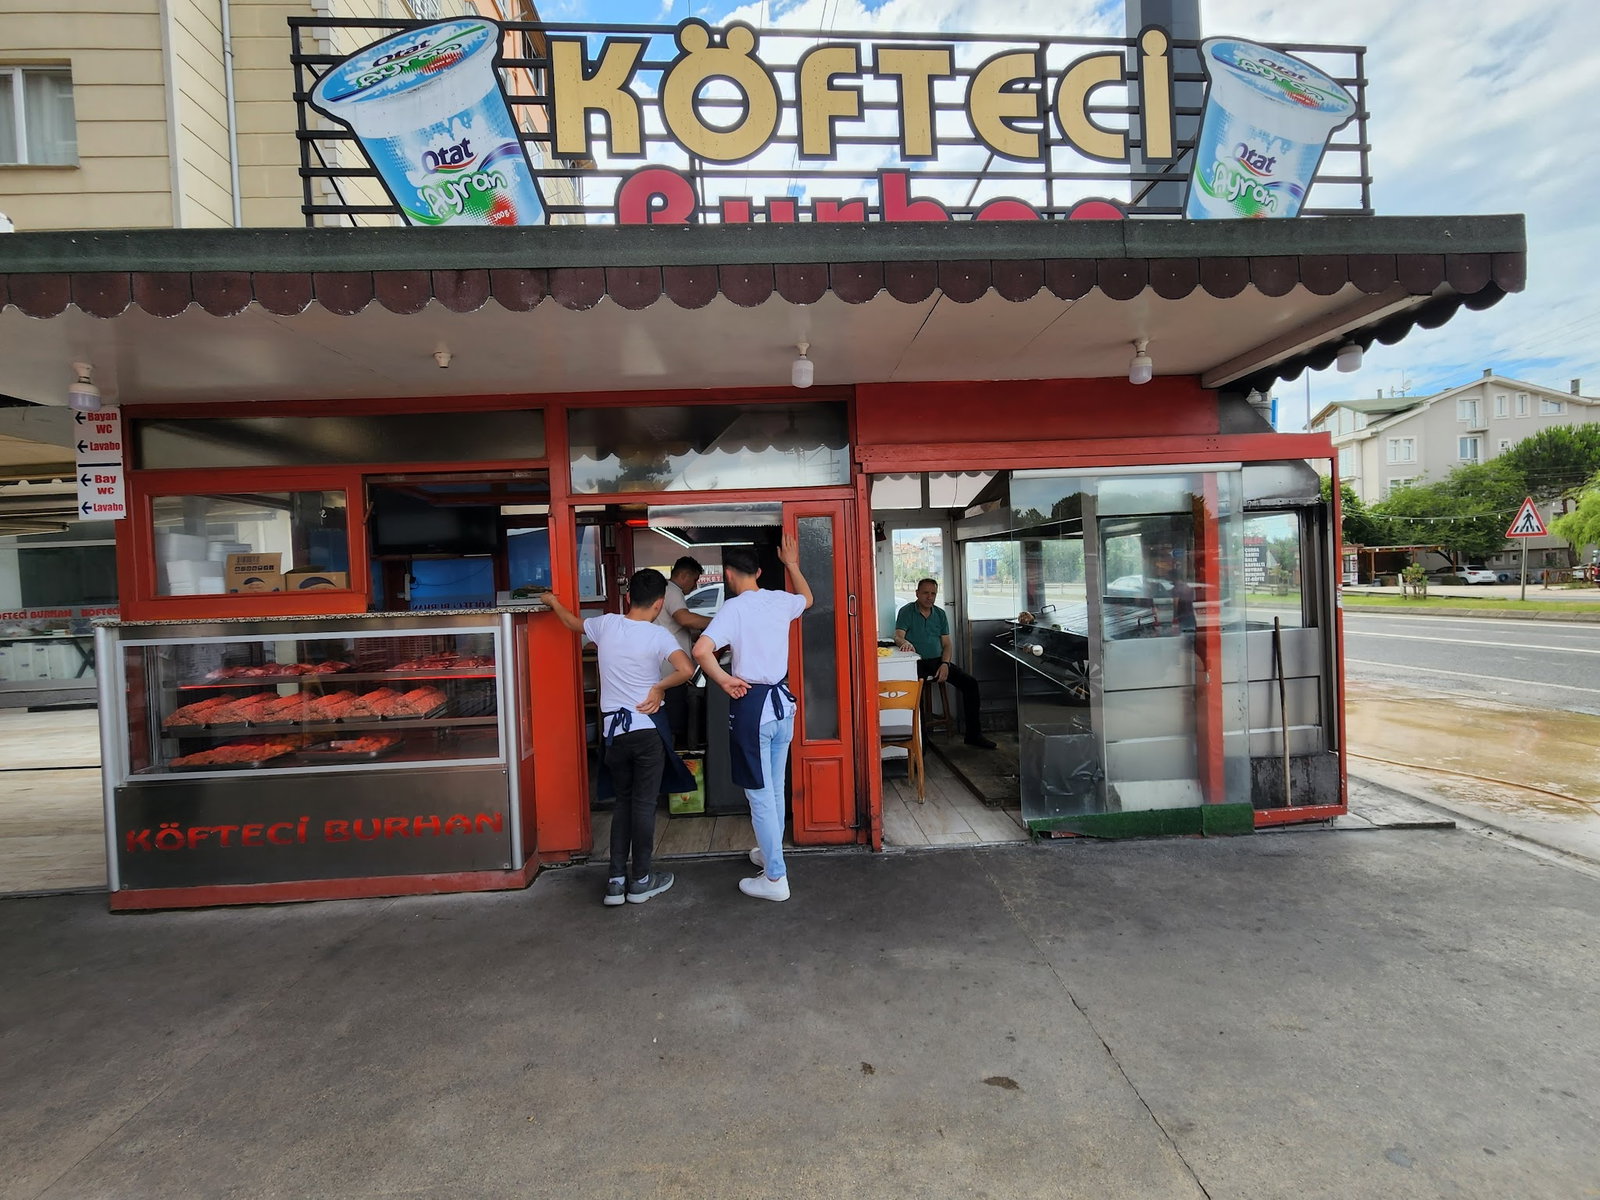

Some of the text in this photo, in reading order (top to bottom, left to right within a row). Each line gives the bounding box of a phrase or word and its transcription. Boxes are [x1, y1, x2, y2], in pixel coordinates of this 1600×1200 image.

[356, 42, 463, 89] Ayran
[548, 17, 1178, 165] KÖFTECİ
[421, 137, 474, 174] Otat
[1232, 142, 1276, 173] Otat
[420, 170, 508, 219] Ayran
[1213, 162, 1279, 213] Ayran
[87, 412, 117, 422] Bayan
[96, 424, 113, 434] WC
[90, 441, 121, 451] Lavabo
[95, 474, 117, 484] Bay
[97, 487, 115, 495] WC
[93, 503, 124, 512] Lavabo
[125, 812, 504, 853] KÖFTECİ BURHAN
